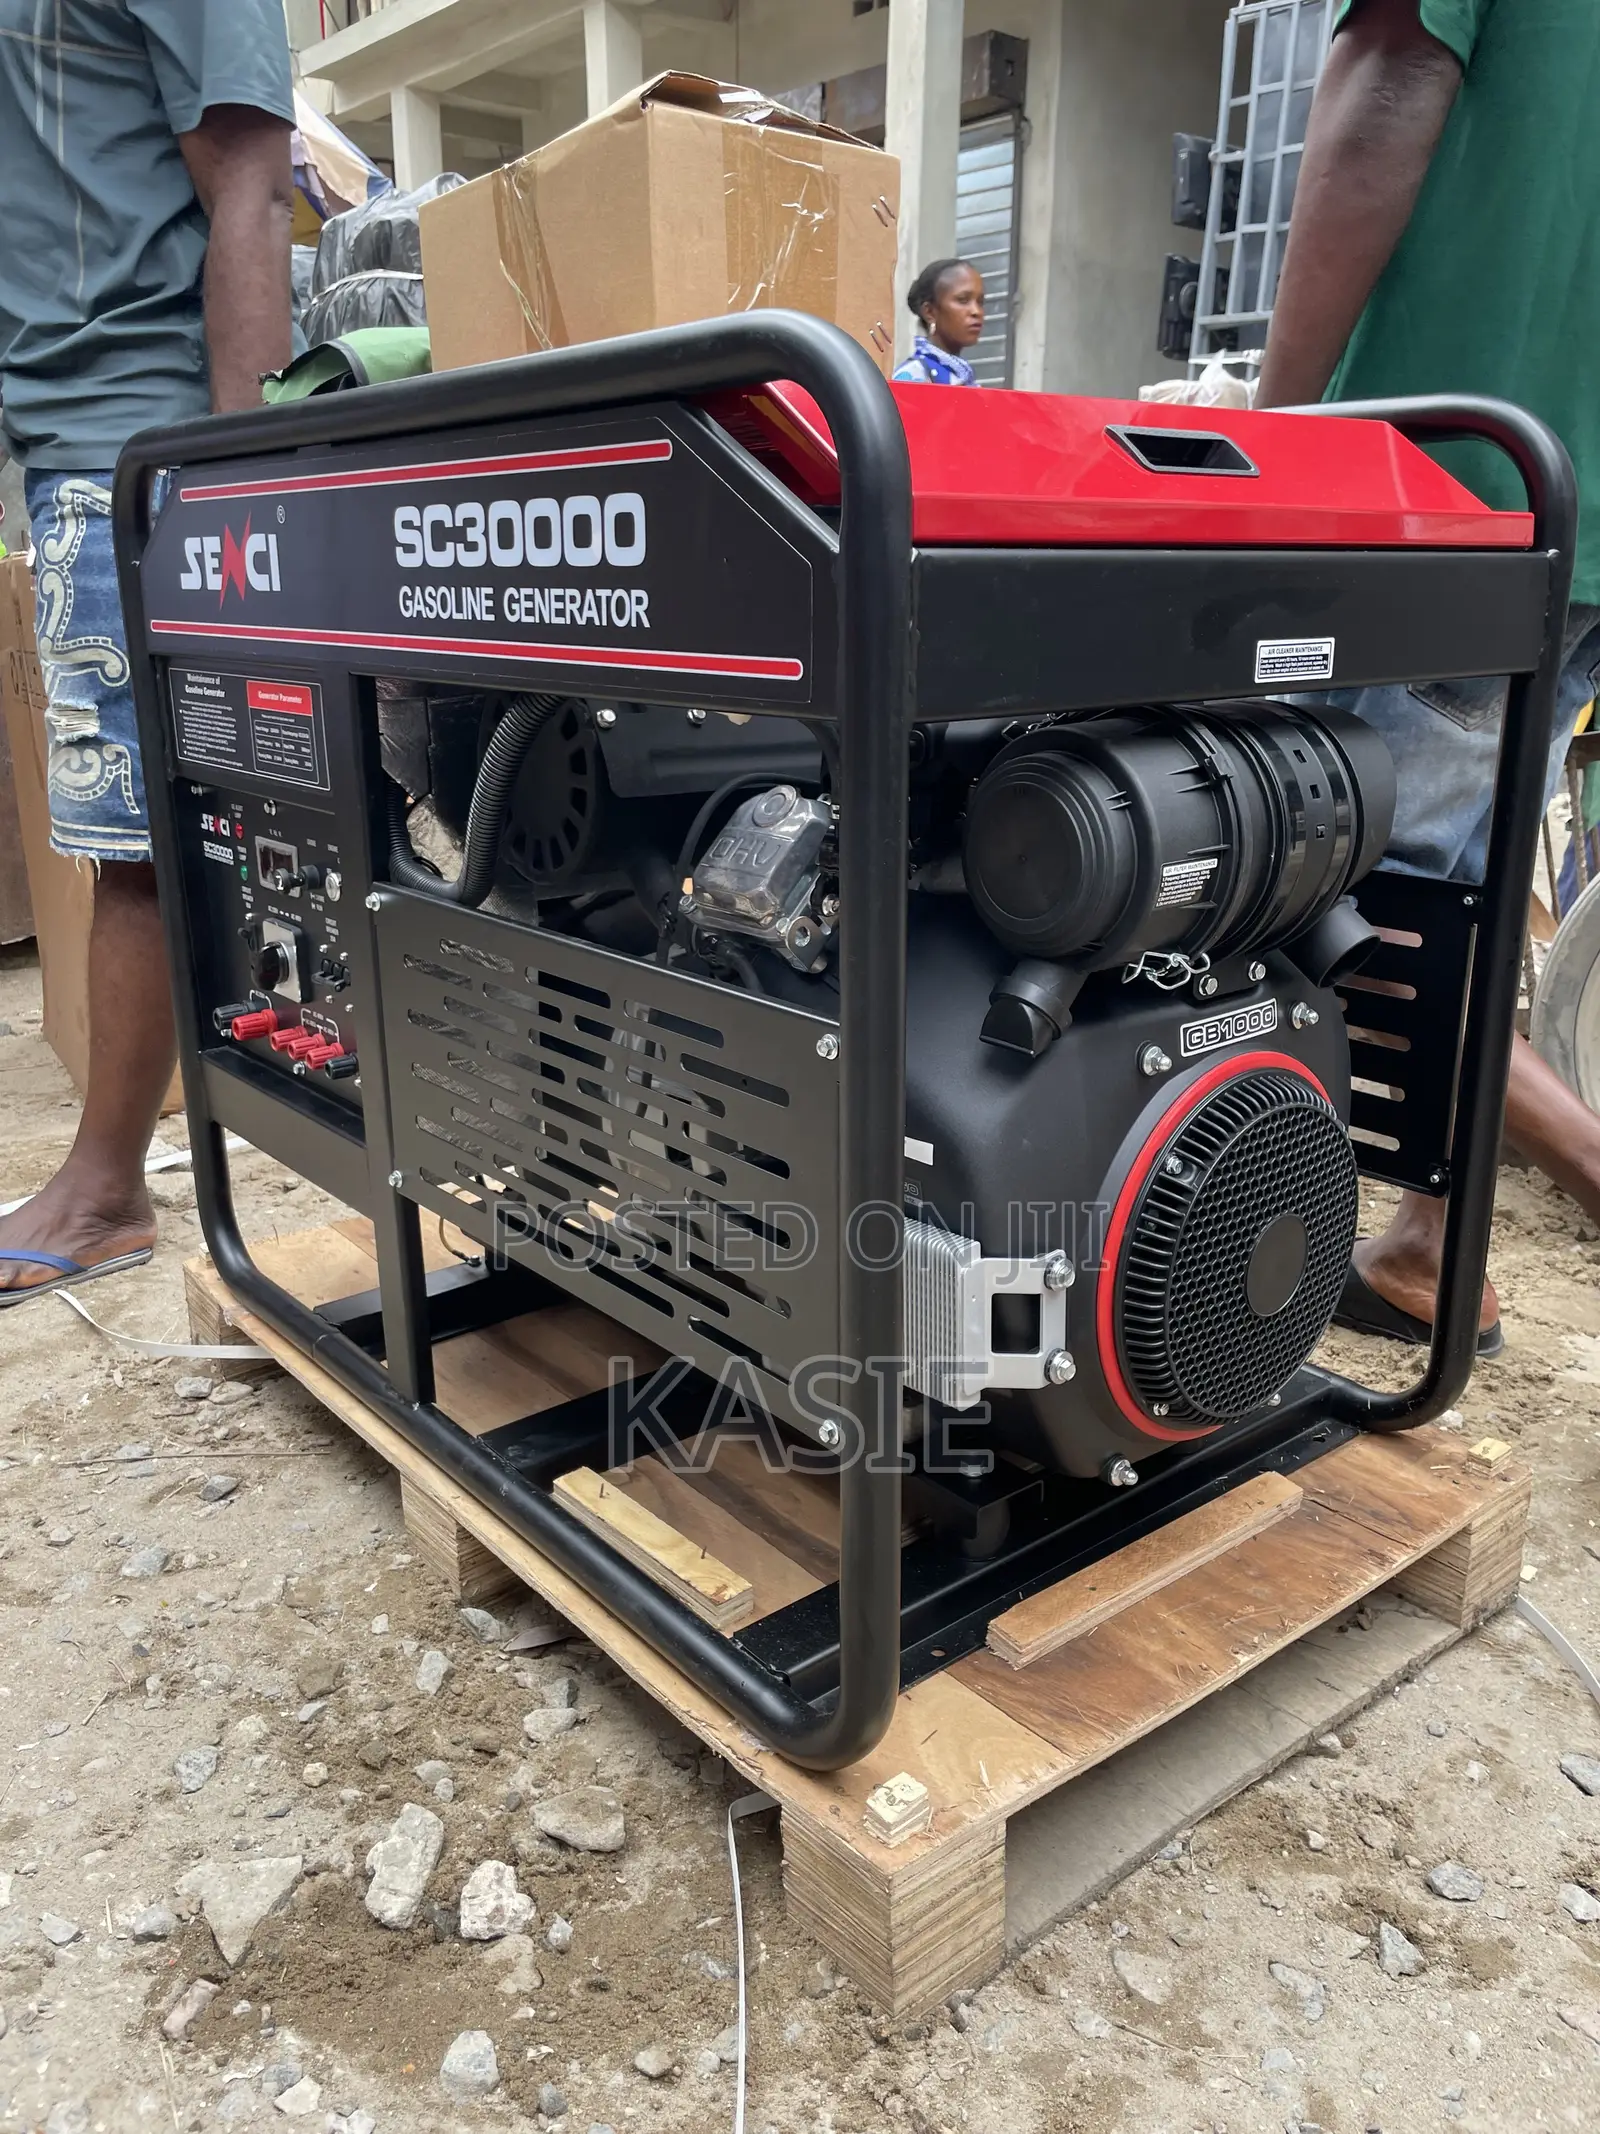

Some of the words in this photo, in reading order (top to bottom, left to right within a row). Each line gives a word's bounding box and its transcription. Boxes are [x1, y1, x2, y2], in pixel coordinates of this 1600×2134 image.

[394, 492, 646, 567] SC30000
[180, 508, 281, 609] SENCI
[399, 585, 495, 622] GASOLINE
[503, 587, 651, 628] GENERATOR
[257, 690, 280, 702] Generator
[201, 812, 231, 837] SENCI
[203, 840, 234, 860] SC30000
[709, 835, 781, 869] OHV
[1186, 1005, 1275, 1050] GB1000
